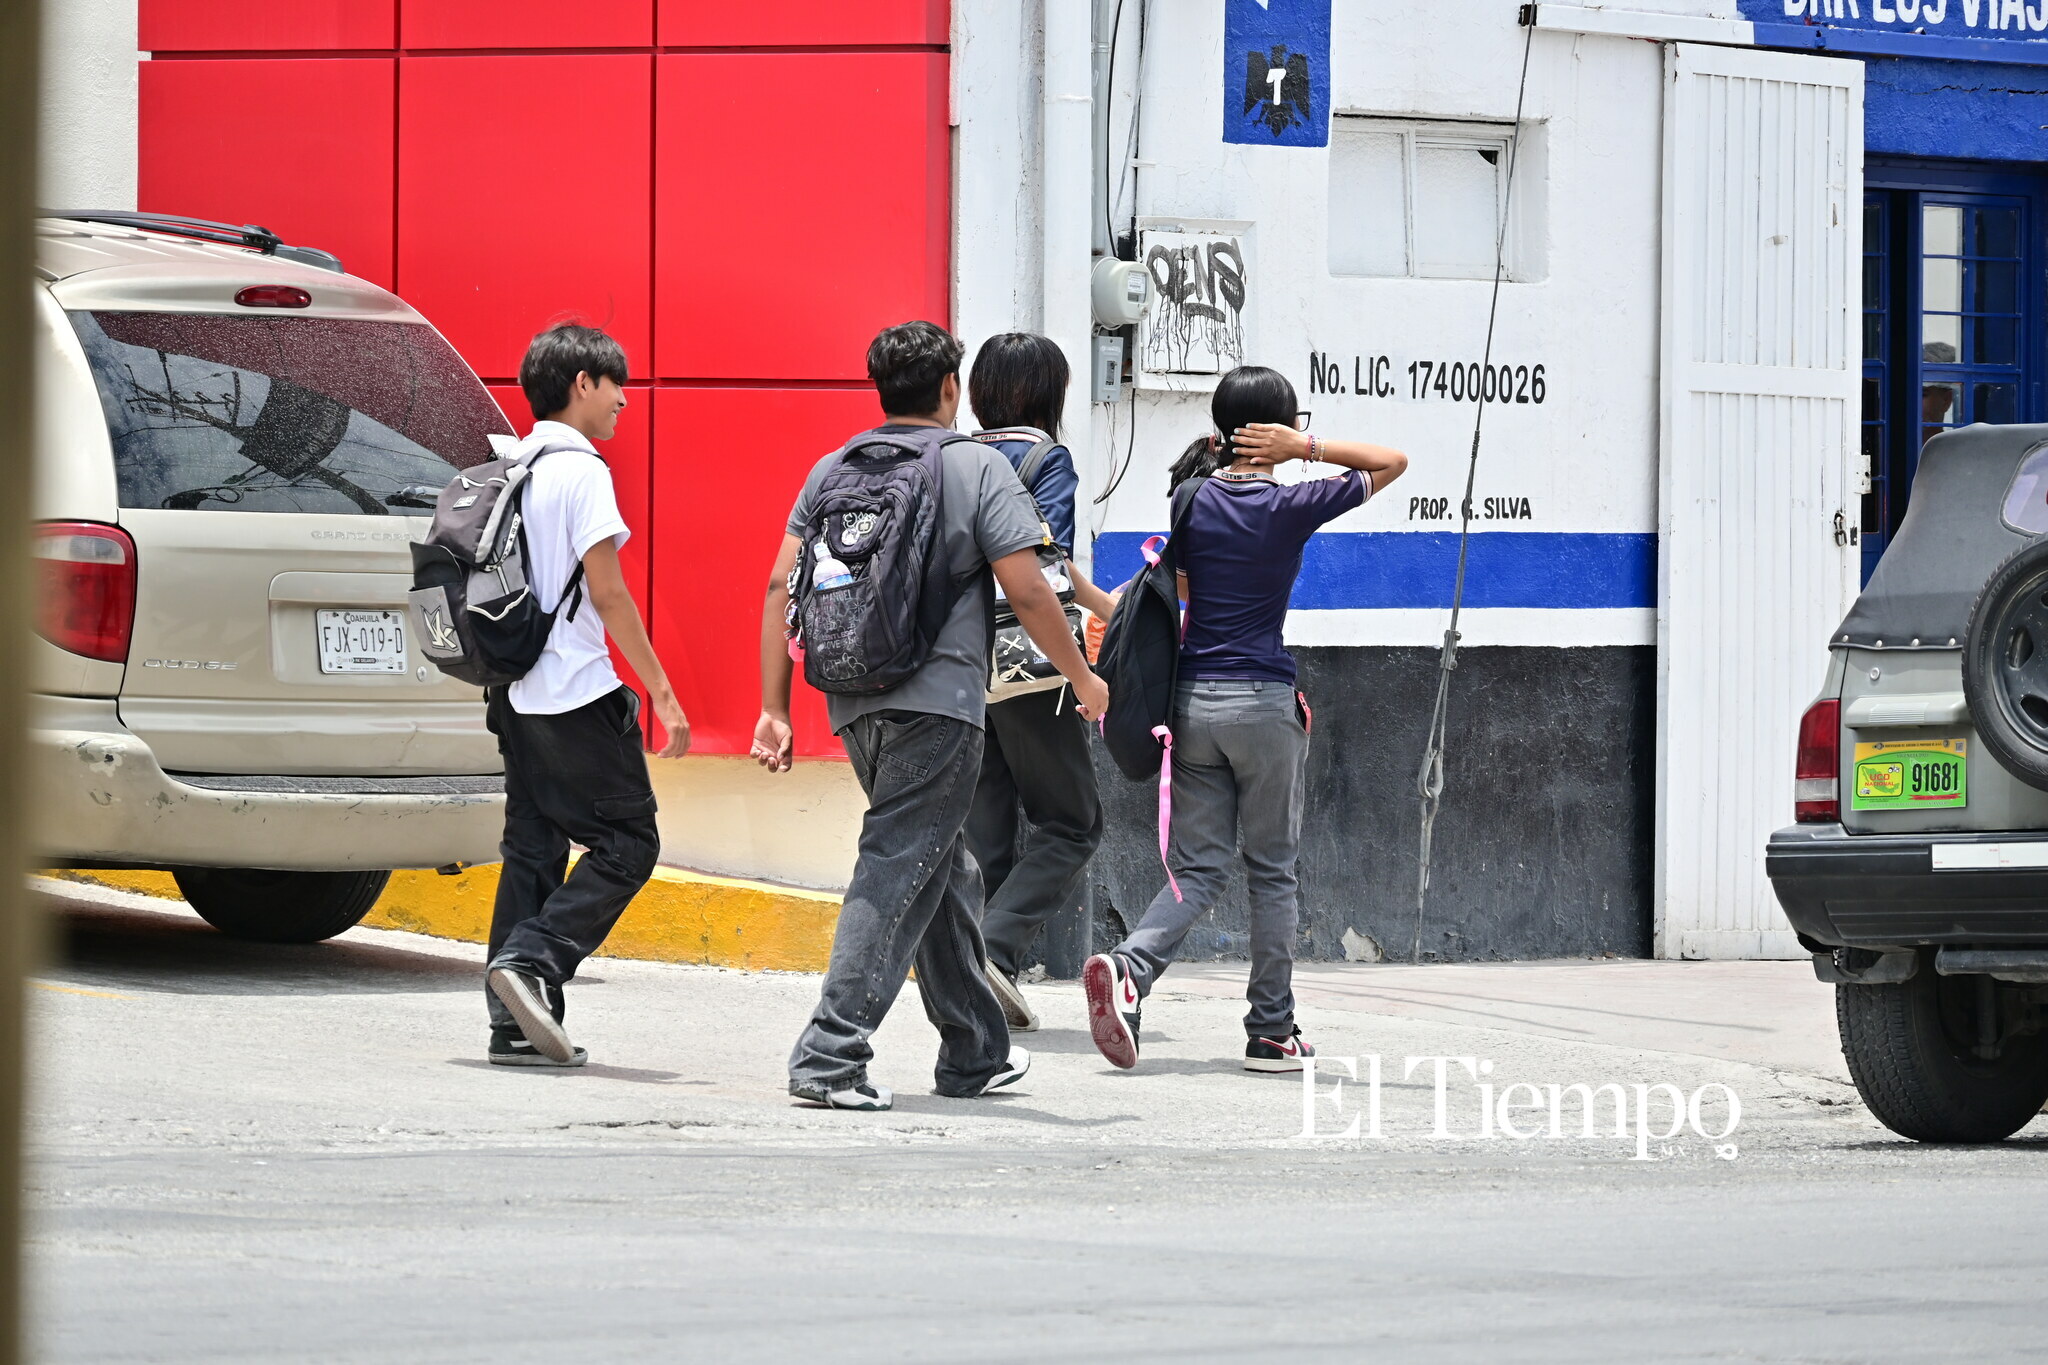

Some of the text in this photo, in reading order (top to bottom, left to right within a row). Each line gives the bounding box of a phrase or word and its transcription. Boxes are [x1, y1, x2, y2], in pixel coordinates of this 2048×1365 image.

[1310, 352, 1547, 404] No. LIC. 174000026
[1245, 472, 1257, 480] 36
[1409, 497, 1452, 520] PROP.
[1484, 497, 1532, 520] SILVA
[343, 612, 380, 624] COAHUILA
[323, 626, 404, 654] FJX-019-D
[143, 658, 238, 671] DODGE
[1869, 773, 1890, 781] UCD
[1911, 762, 1959, 793] 91681
